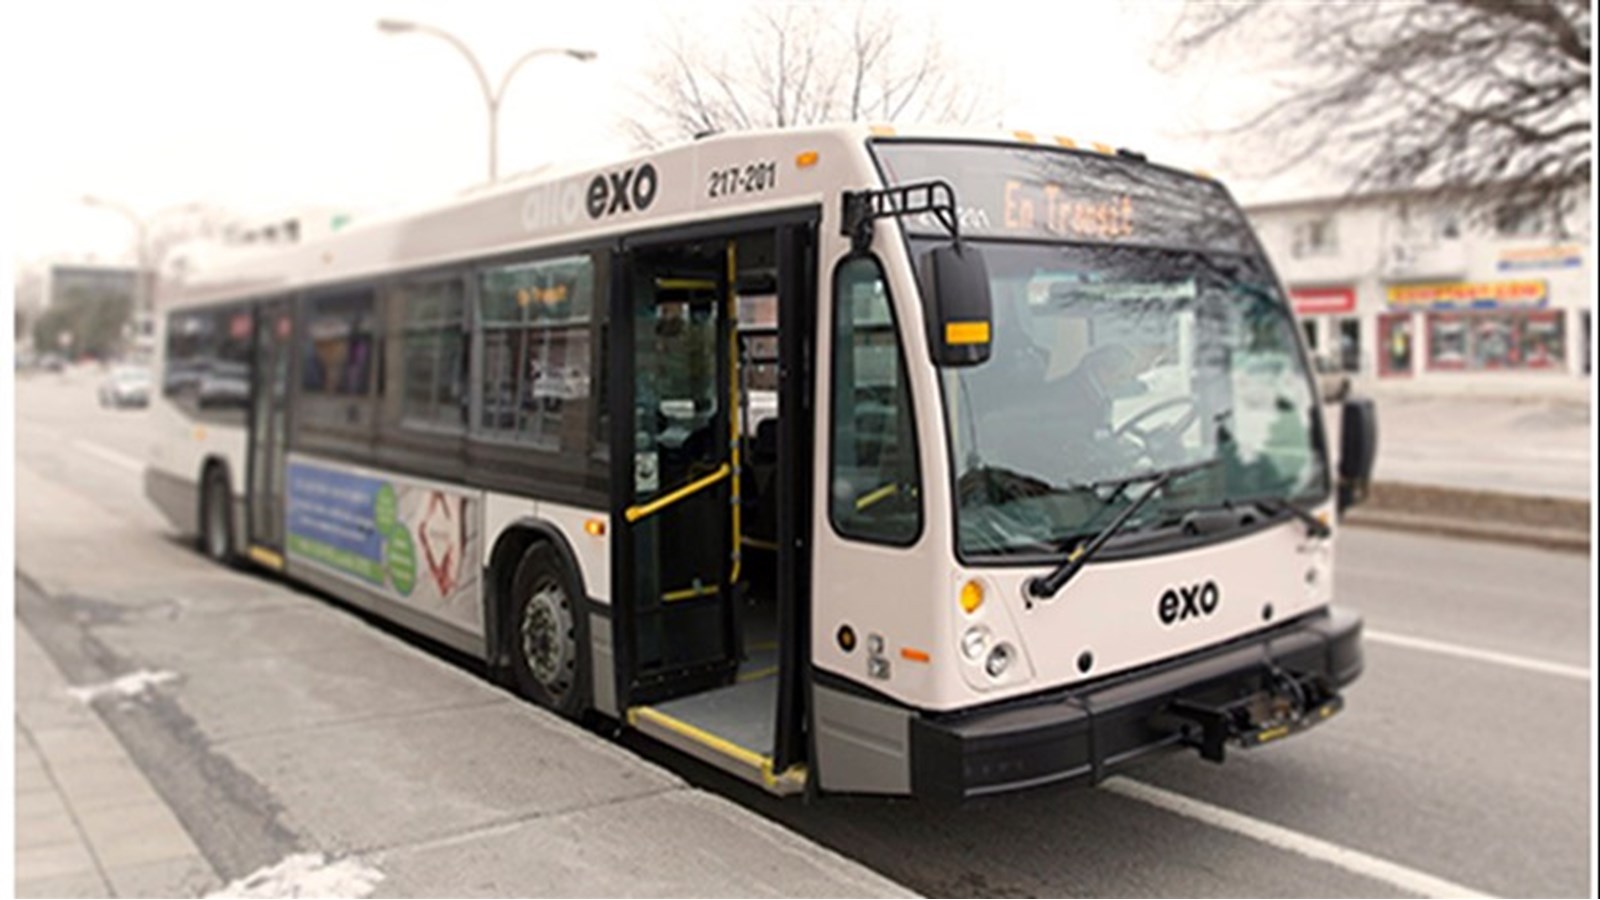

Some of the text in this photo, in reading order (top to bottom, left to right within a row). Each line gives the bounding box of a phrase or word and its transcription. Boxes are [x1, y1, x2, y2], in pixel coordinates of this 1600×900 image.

[585, 162, 657, 220] exo
[708, 161, 776, 198] 217-201
[1004, 180, 1034, 229] En
[1043, 183, 1134, 237] Transit
[1158, 579, 1219, 625] exo
